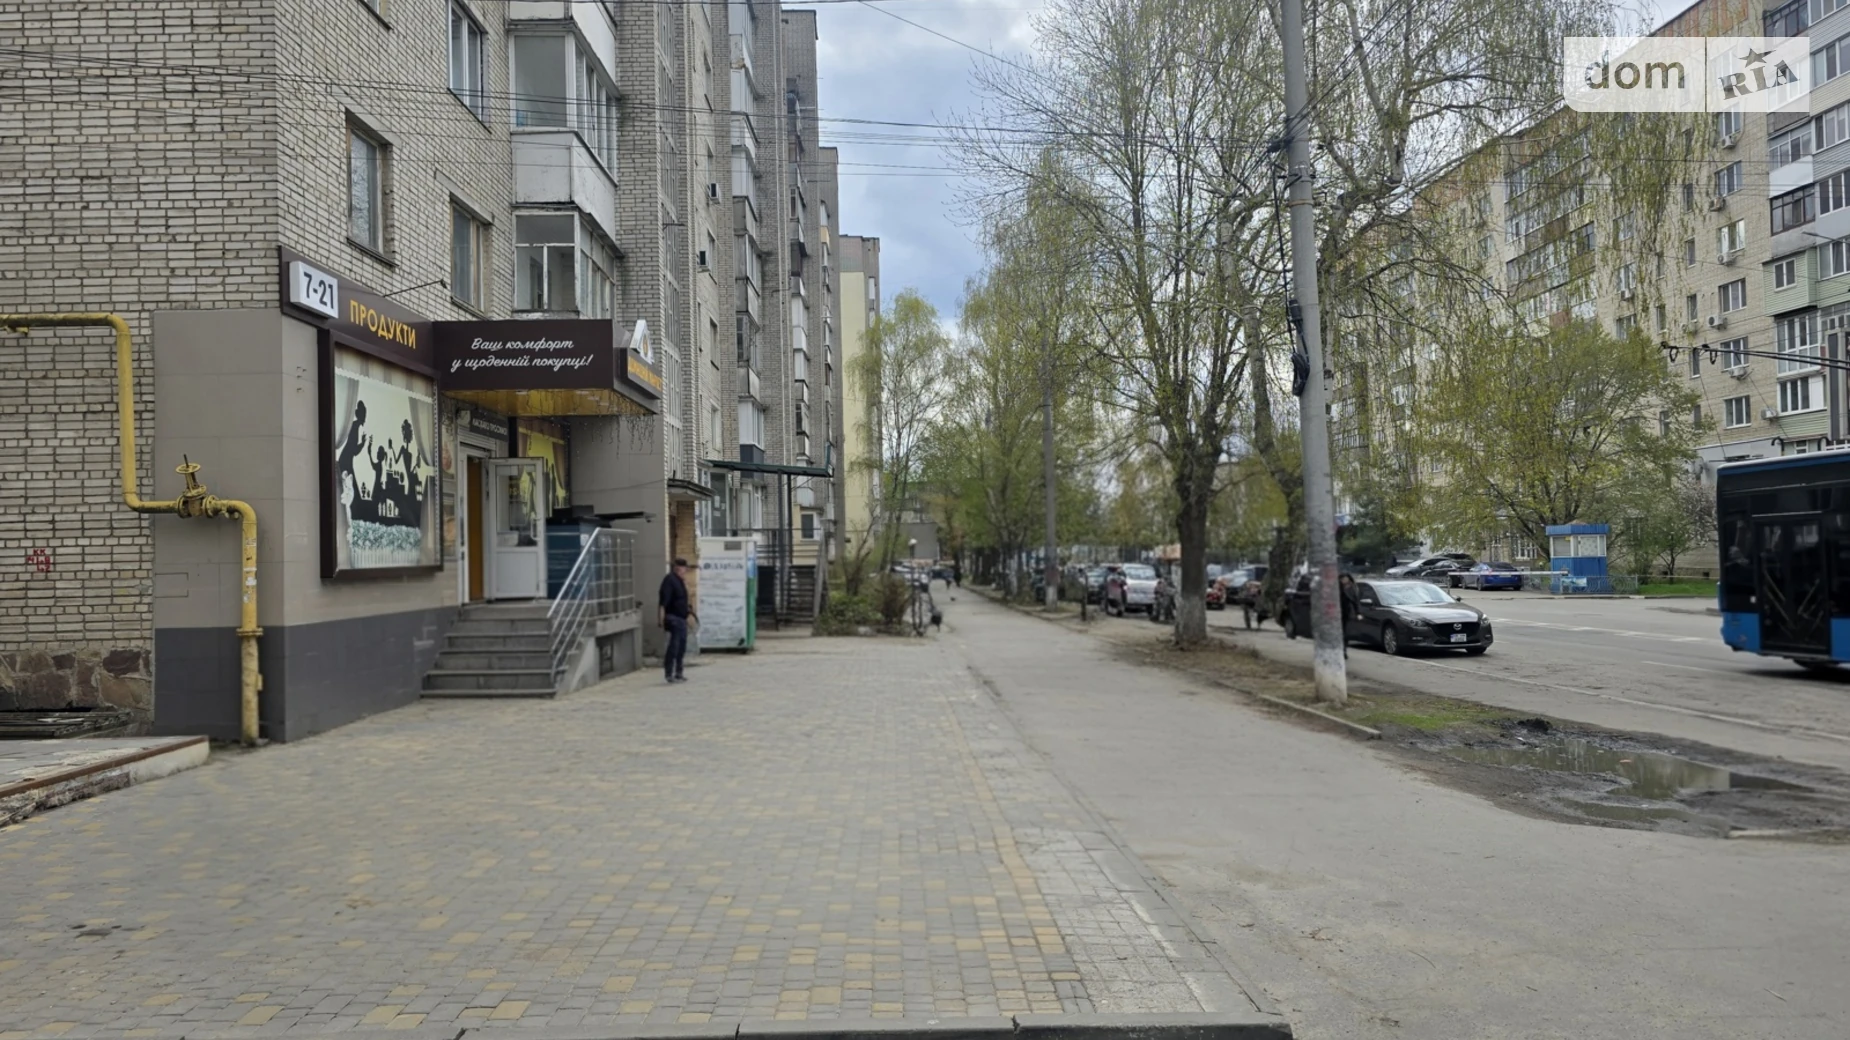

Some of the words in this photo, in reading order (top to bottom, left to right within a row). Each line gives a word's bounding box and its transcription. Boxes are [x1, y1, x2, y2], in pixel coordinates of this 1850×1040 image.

[303, 271, 334, 310] 7-21
[349, 299, 416, 349] ПРОДУКТИ
[471, 337, 503, 352] Ваш
[505, 336, 574, 352] комфорт
[450, 358, 462, 373] у
[464, 355, 530, 371] щоденній
[532, 354, 594, 372] покупці!
